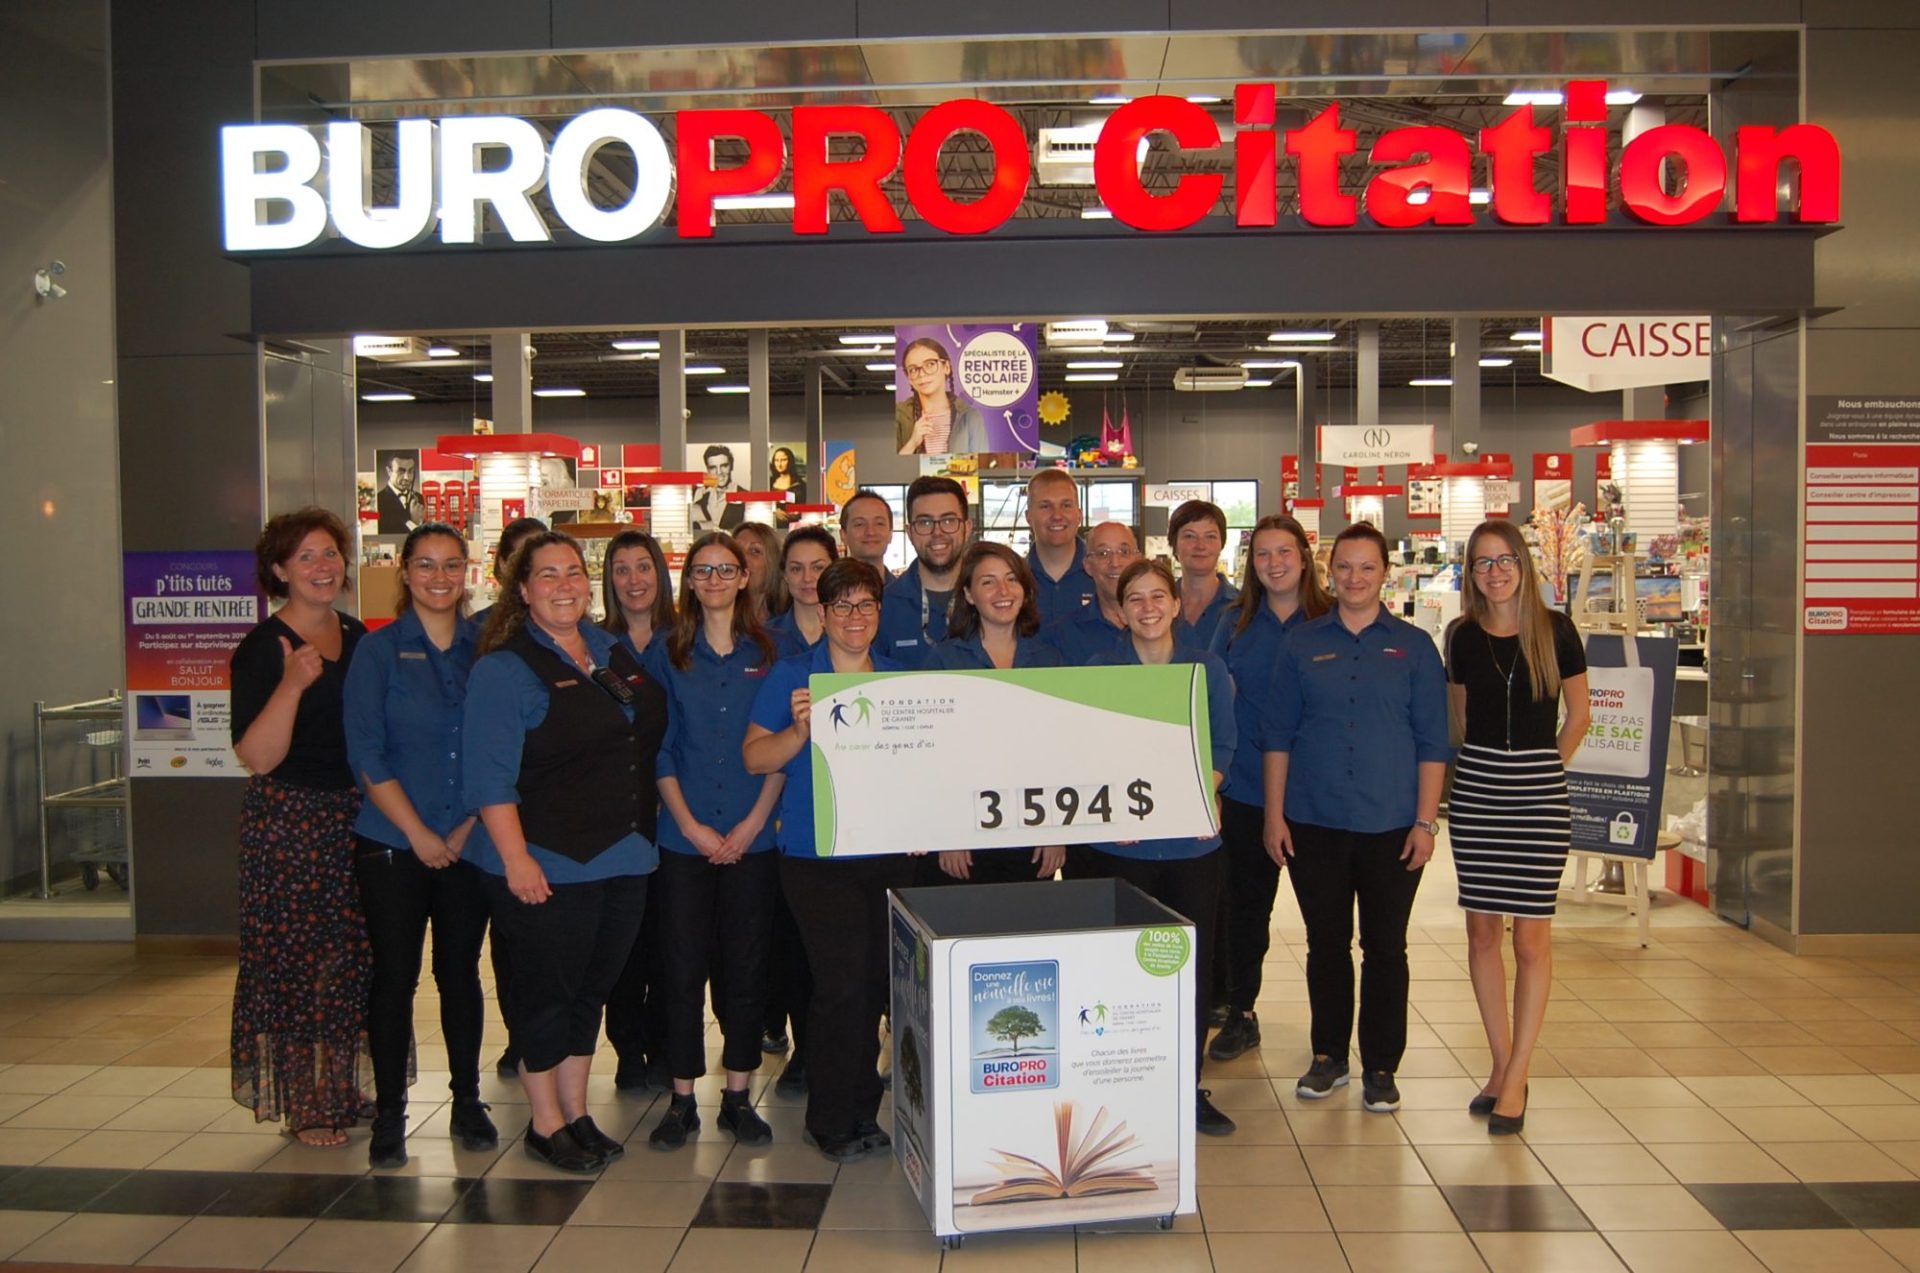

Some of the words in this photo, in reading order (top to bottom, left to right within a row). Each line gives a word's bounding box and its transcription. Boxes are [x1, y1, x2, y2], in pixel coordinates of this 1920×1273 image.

[221, 99, 1031, 251] BUROPRO
[1094, 81, 1841, 231] Citation
[1582, 322, 1711, 357] CAISSE
[964, 355, 1028, 371] RENTRÉE
[964, 373, 1028, 384] SCOLAIRE
[982, 388, 1014, 396] Hamster
[1838, 400, 1863, 409] Nous
[1343, 450, 1381, 459] CAROLINE
[1384, 449, 1411, 458] NÉRON
[1153, 489, 1201, 501] CAISSES
[156, 574, 194, 596] p'tits
[196, 574, 232, 592] futés
[135, 600, 192, 619] GRANDE
[194, 596, 254, 618] RENTRÉE
[1807, 617, 1844, 625] Citation
[138, 640, 179, 651] Participez
[180, 641, 194, 649] sur
[179, 665, 214, 675] SALUT
[171, 676, 224, 687] BONJOUR
[1589, 688, 1625, 699] ROPRO
[880, 698, 955, 706] FONDATION
[1588, 698, 1624, 709] tation
[1620, 715, 1645, 727] PAS
[1610, 726, 1644, 740] SAC
[873, 741, 890, 750] des
[892, 742, 914, 755] gens
[1583, 738, 1641, 752] ILISABLE
[1613, 788, 1650, 799] PLASTIQUE
[979, 790, 1004, 830] 3
[1023, 784, 1112, 827] 594
[1126, 777, 1155, 822] $
[1148, 930, 1181, 944] 100%
[974, 971, 1013, 982] Donnez
[973, 971, 1032, 1004] nouvelle
[1033, 977, 1054, 993] vie
[1090, 1048, 1116, 1057] Chacun
[983, 1059, 1047, 1074] BUROPRO
[983, 1071, 1047, 1087] Citation
